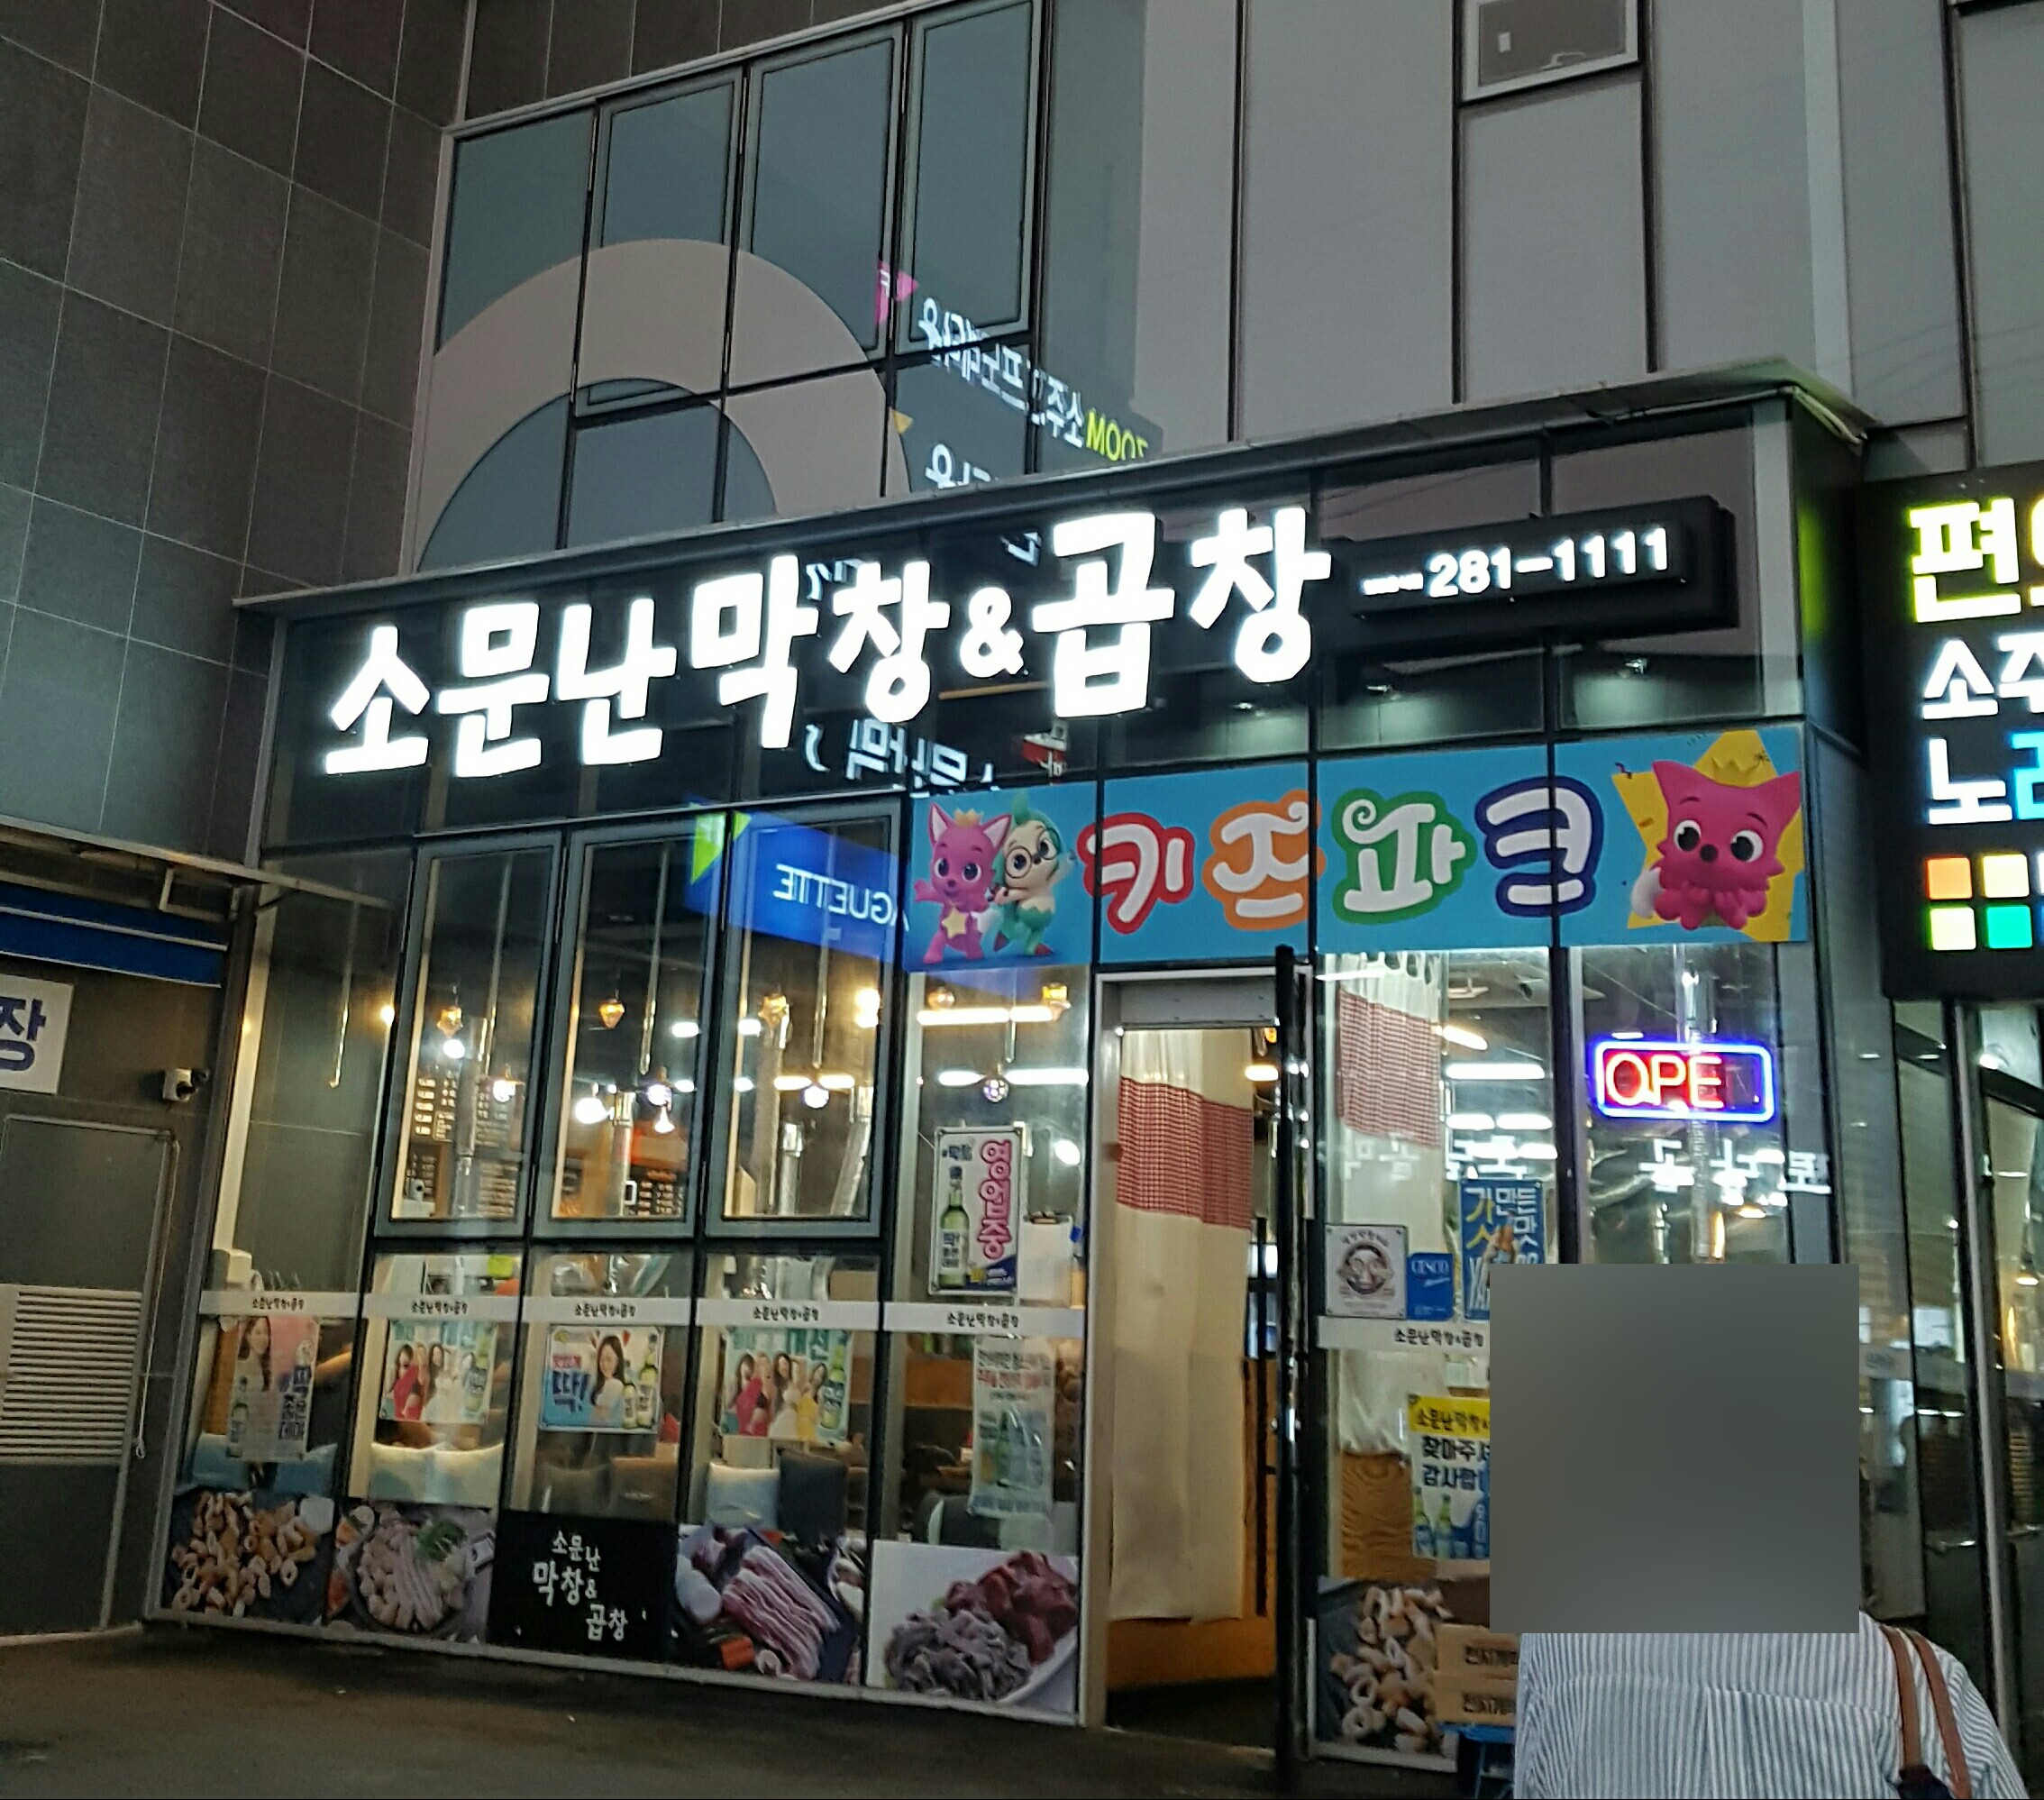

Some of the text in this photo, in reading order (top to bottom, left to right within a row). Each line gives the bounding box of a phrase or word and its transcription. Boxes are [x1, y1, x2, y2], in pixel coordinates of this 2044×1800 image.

[1909, 494, 2044, 623] 편
[1078, 776, 1602, 934] 키즈파크
[552, 1530, 601, 1573] 소문난
[586, 1604, 629, 1642] 곱창
